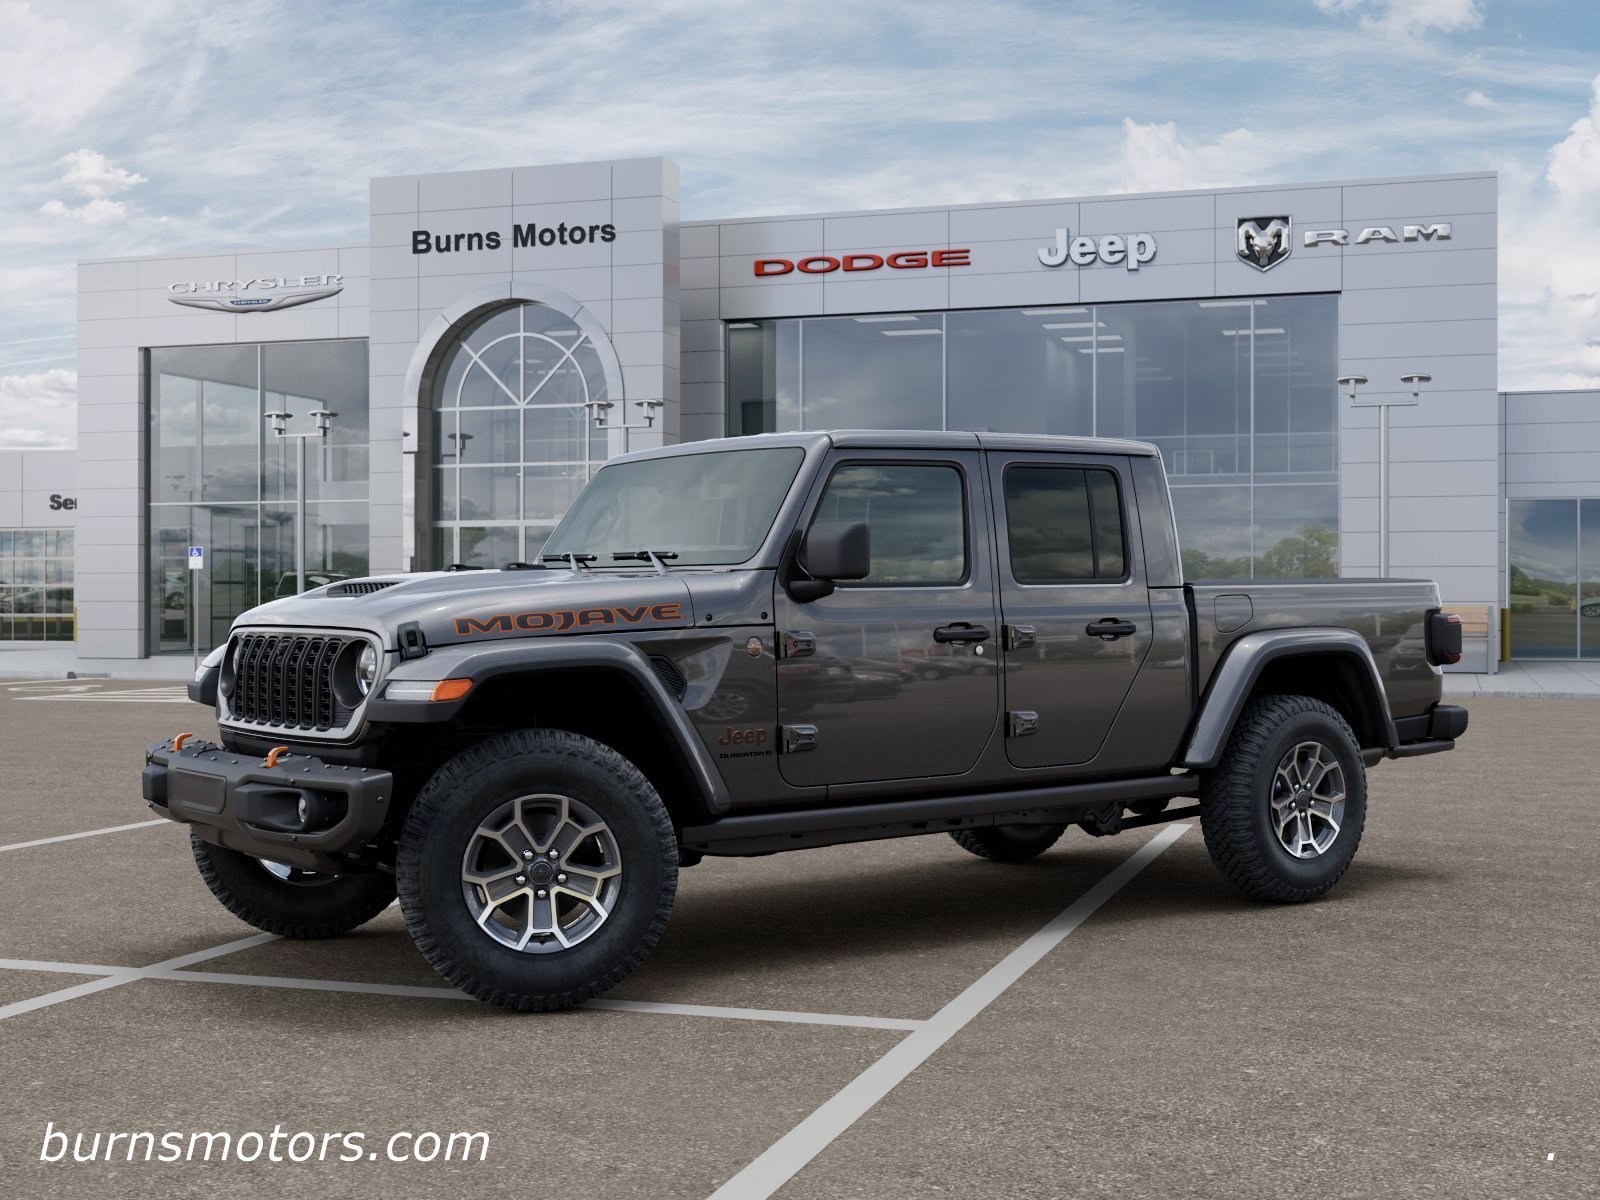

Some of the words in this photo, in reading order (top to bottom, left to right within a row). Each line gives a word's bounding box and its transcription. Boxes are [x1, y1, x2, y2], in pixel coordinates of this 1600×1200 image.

[412, 230, 501, 254] Burns
[512, 222, 616, 248] Motors
[1303, 222, 1453, 247] RAM
[754, 249, 971, 277] DODGE
[1037, 228, 1158, 272] Jeep
[167, 273, 343, 294] CHRYSLER
[454, 604, 682, 636] MOJAVE
[718, 726, 767, 747] Jeep
